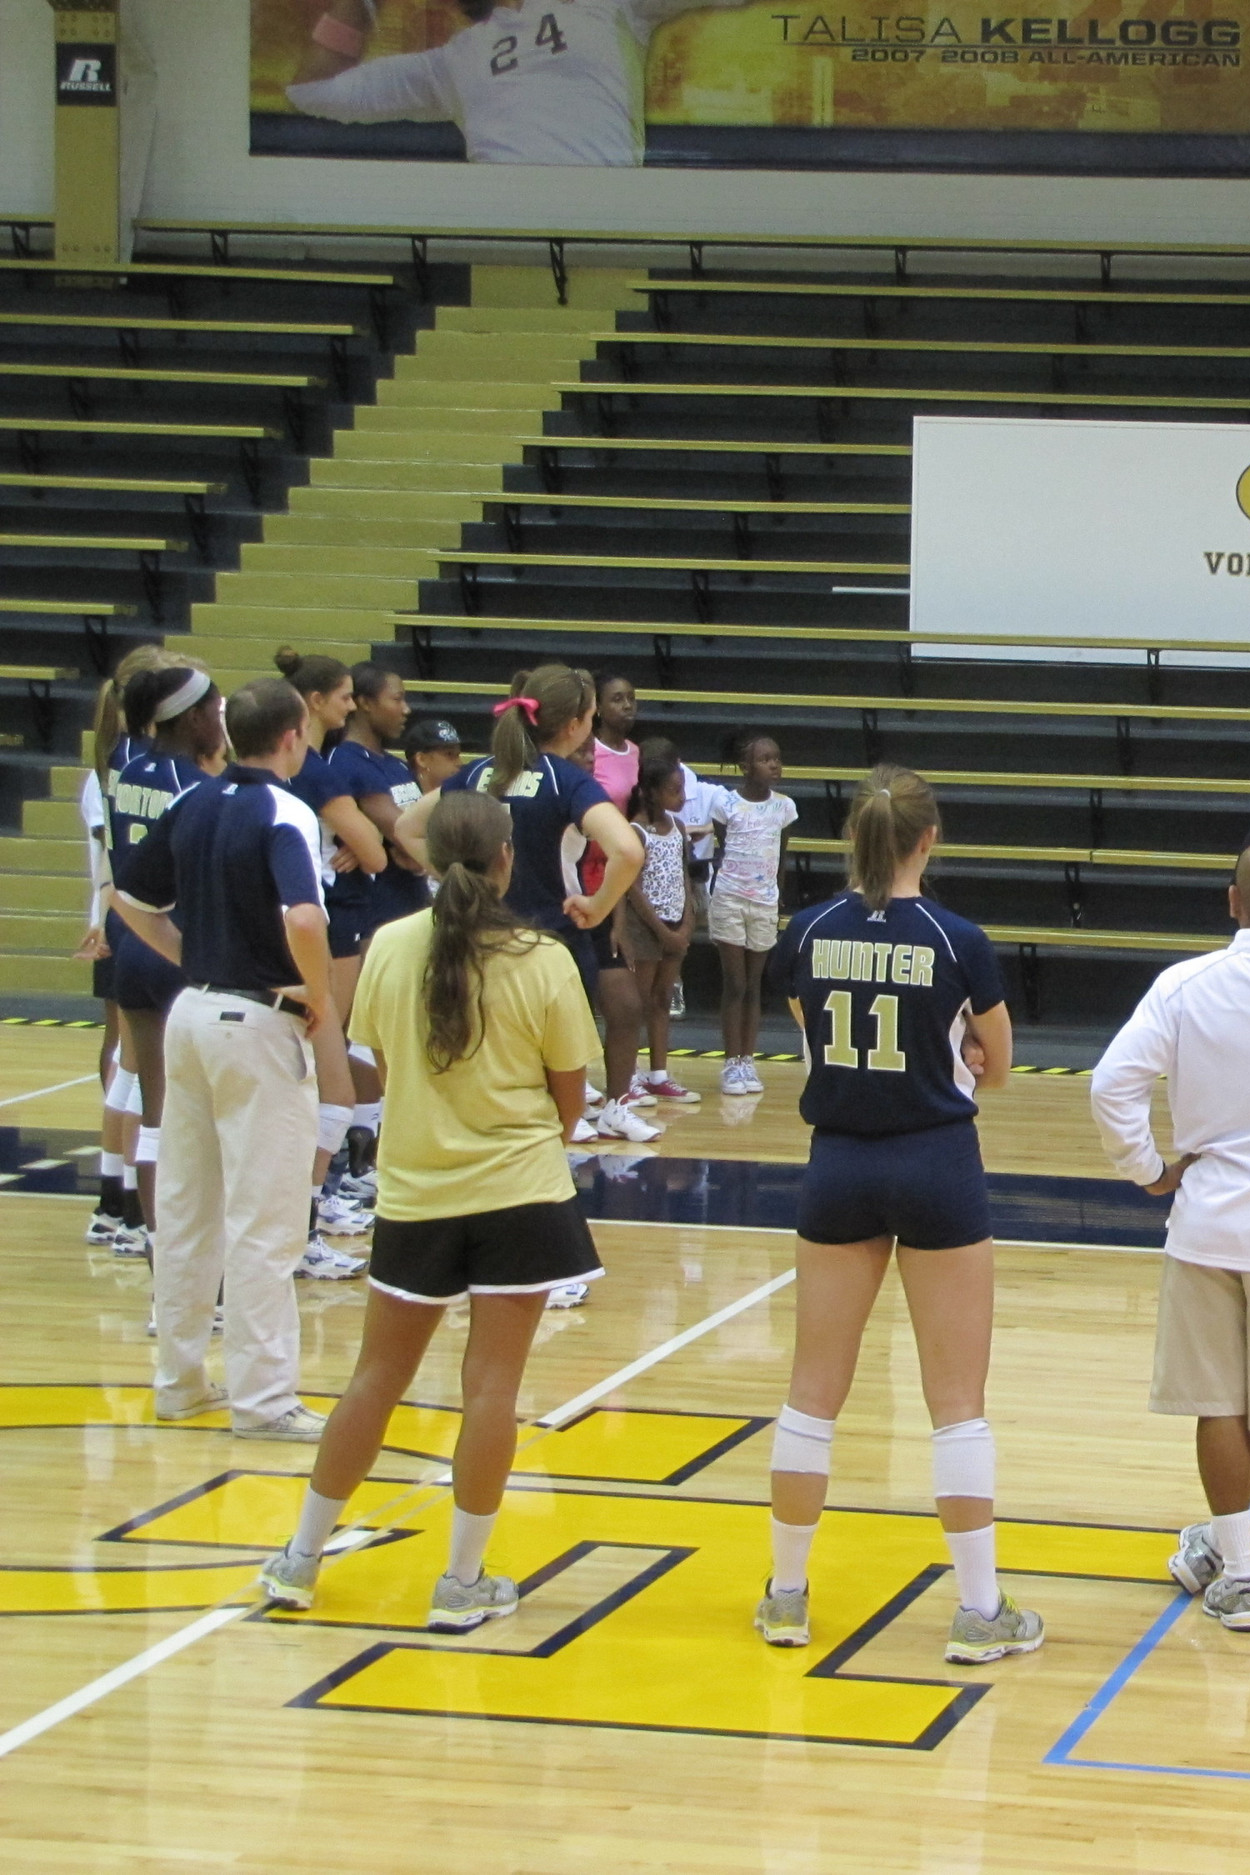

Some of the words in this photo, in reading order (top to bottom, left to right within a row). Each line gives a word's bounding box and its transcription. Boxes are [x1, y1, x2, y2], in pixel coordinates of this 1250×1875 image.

[490, 13, 568, 76] 24
[771, 14, 962, 43] TALISA
[980, 17, 1241, 47] KELLOGG
[851, 48, 927, 63] 2007
[941, 49, 1020, 64] 2008
[1028, 50, 1241, 67] ALL-AMERICAN
[812, 938, 936, 988] HUNTER
[823, 990, 907, 1073] 11
